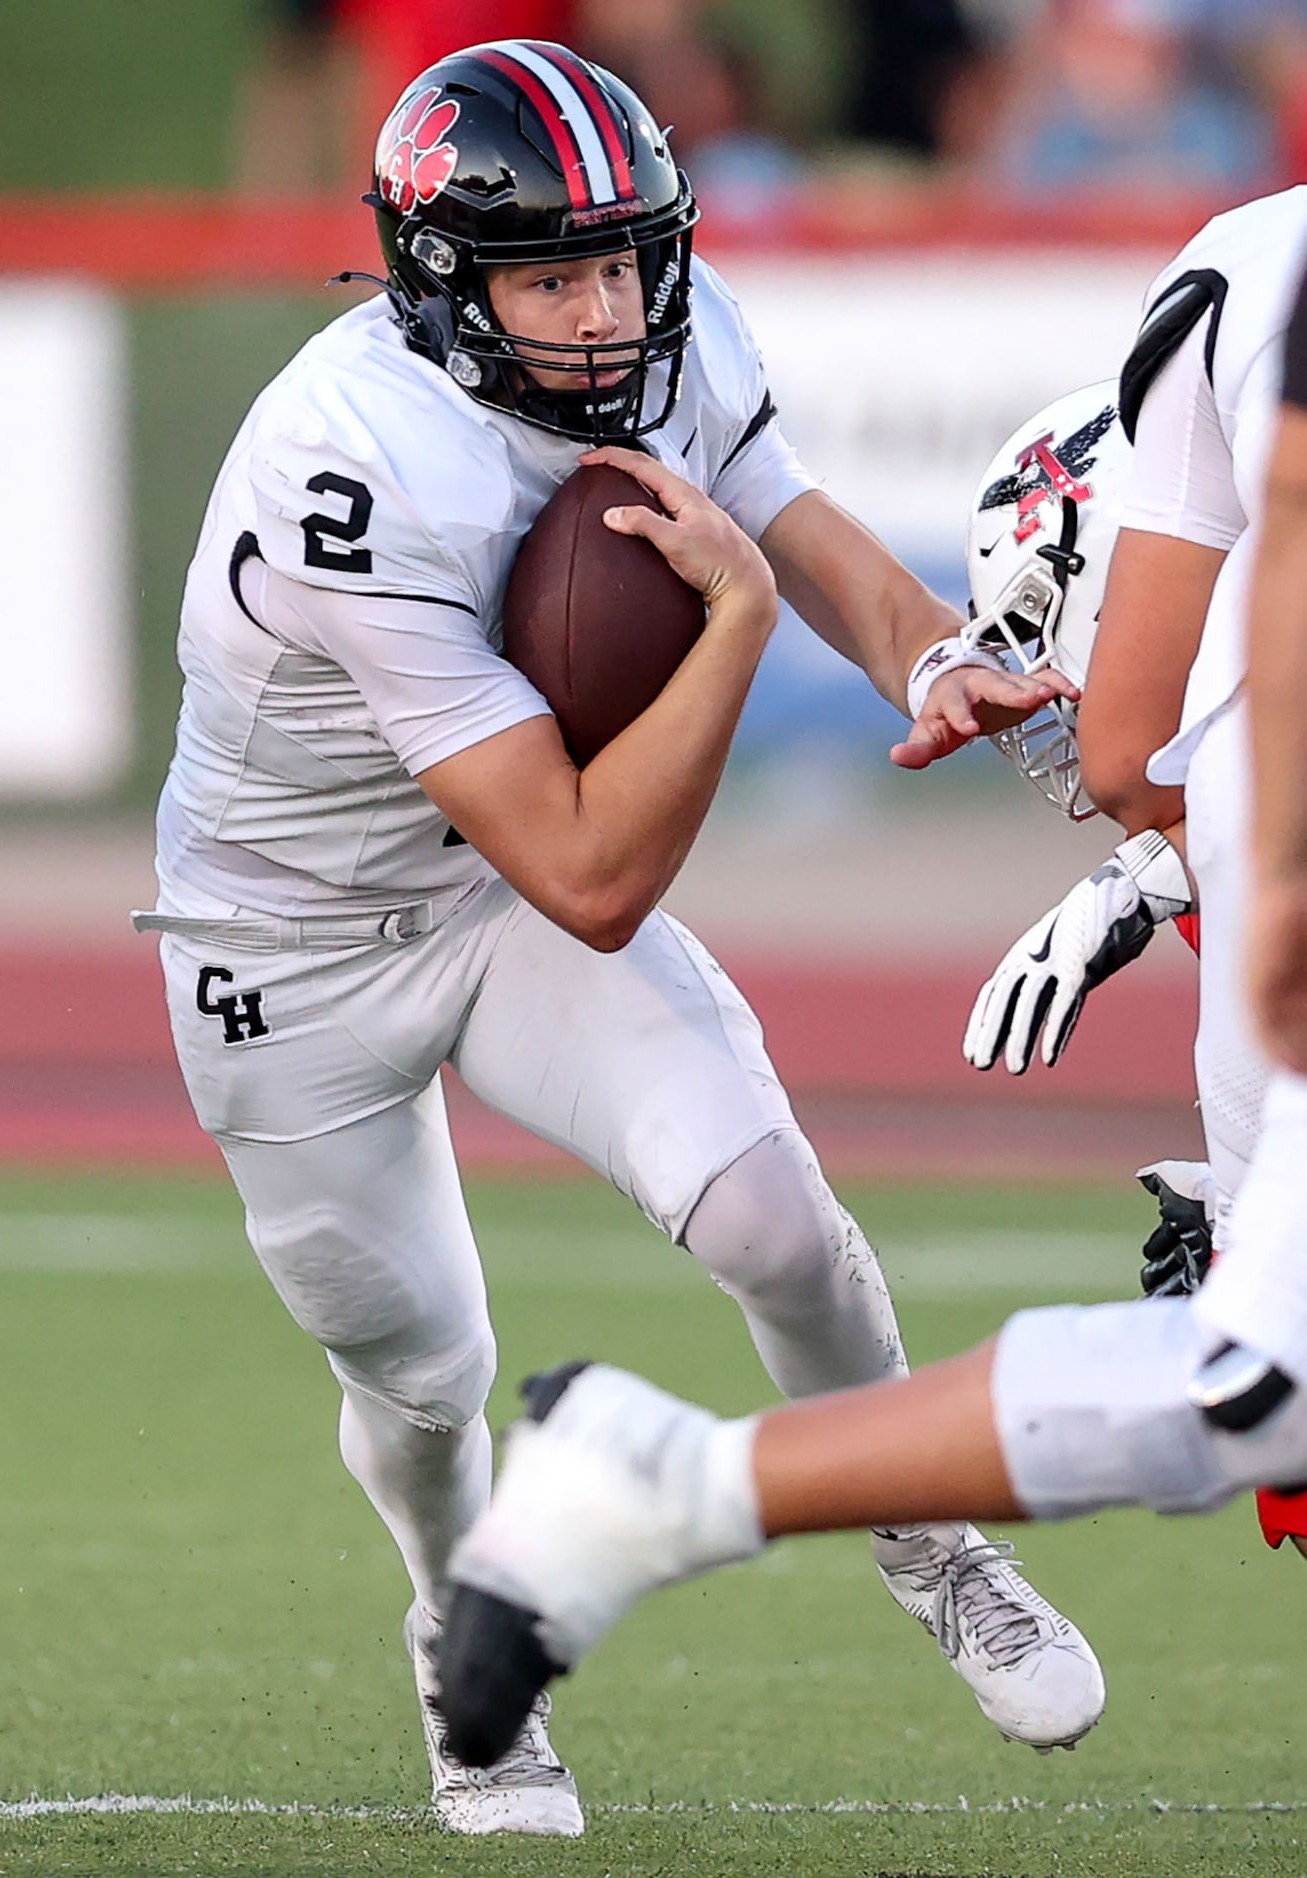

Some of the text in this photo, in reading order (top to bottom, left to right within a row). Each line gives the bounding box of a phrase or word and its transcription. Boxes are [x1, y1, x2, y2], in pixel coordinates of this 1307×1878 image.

[647, 261, 679, 325] Riddell
[585, 398, 625, 416] Rddell
[299, 470, 374, 574] 2
[197, 966, 271, 1044] CH
